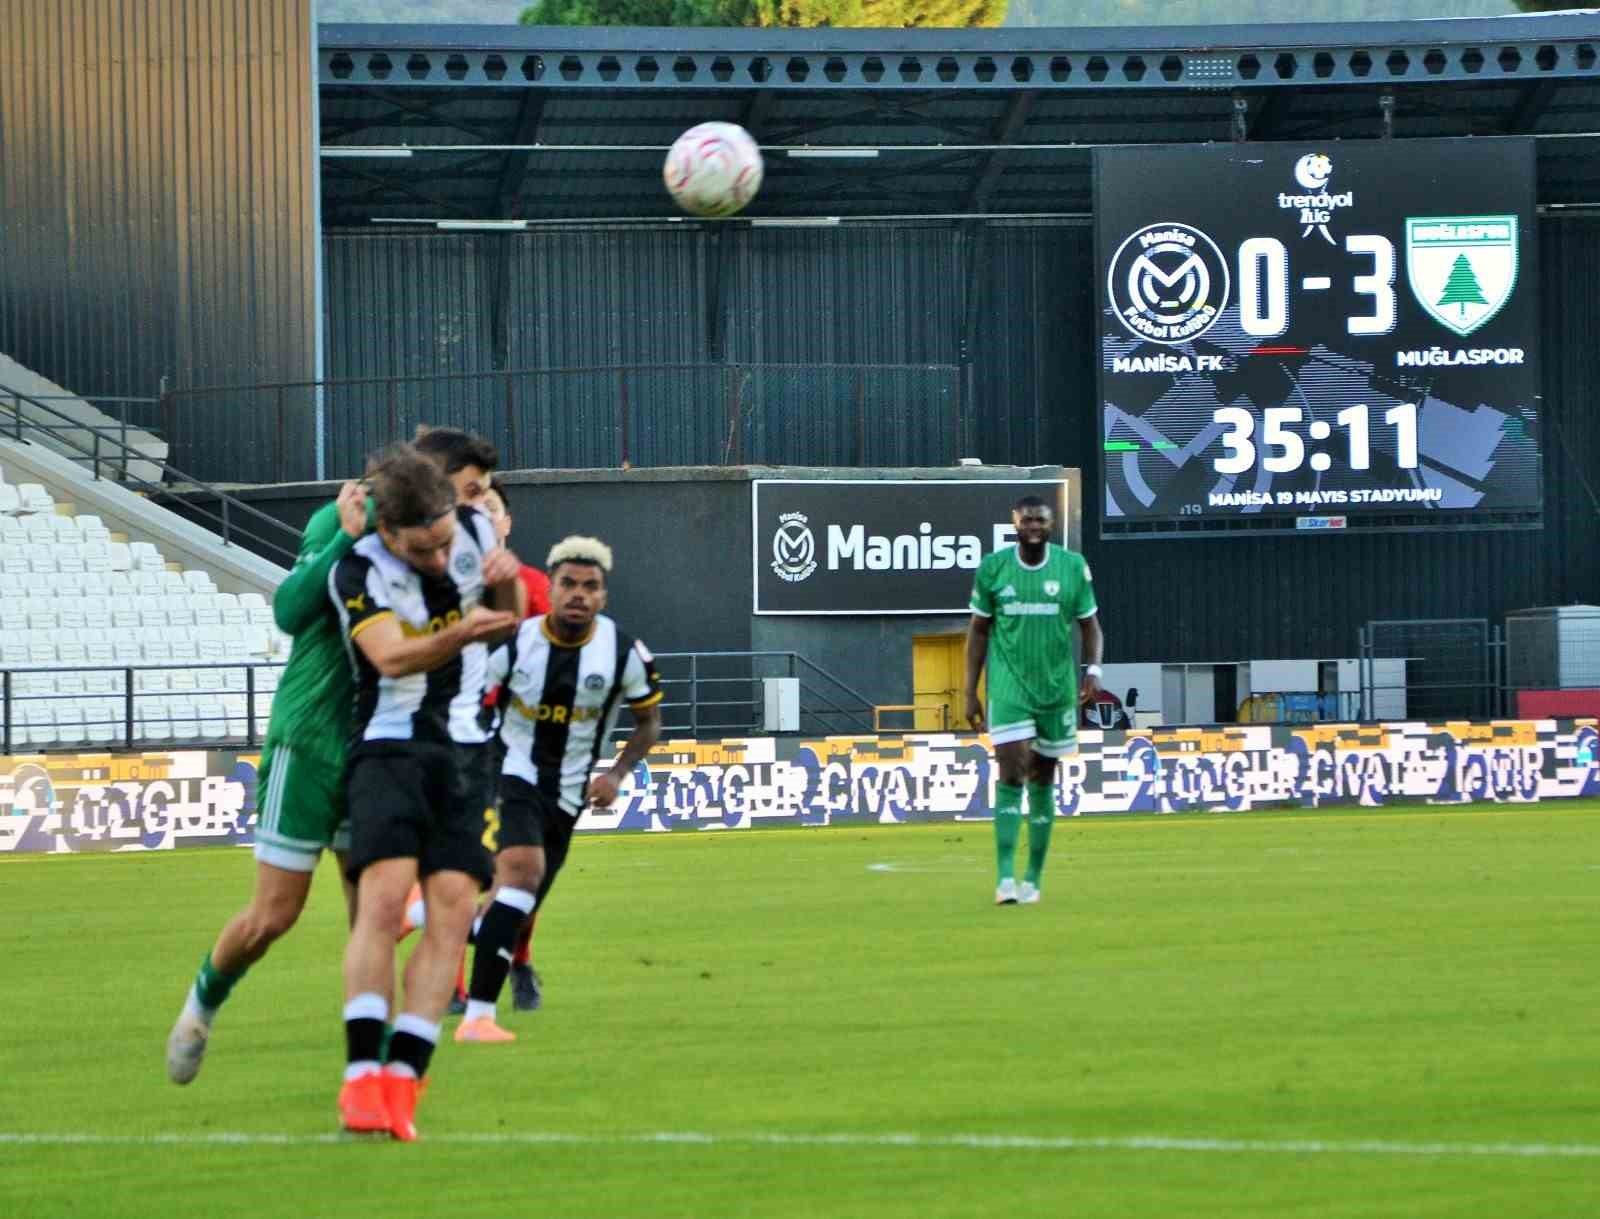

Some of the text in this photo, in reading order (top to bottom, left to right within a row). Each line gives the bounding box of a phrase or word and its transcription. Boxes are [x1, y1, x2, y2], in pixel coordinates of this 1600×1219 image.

[1278, 191, 1352, 210] trendyol
[1239, 238, 1288, 335] 0
[1346, 235, 1396, 334] 3
[1113, 354, 1223, 374] MANİSA FK
[1397, 346, 1524, 366] MUĞLASPOR
[1213, 403, 1418, 474] 35:11
[1209, 489, 1273, 506] MANİSA
[1277, 491, 1293, 505] 19
[1350, 488, 1442, 504] STADYUMU
[827, 522, 982, 570] Manisa
